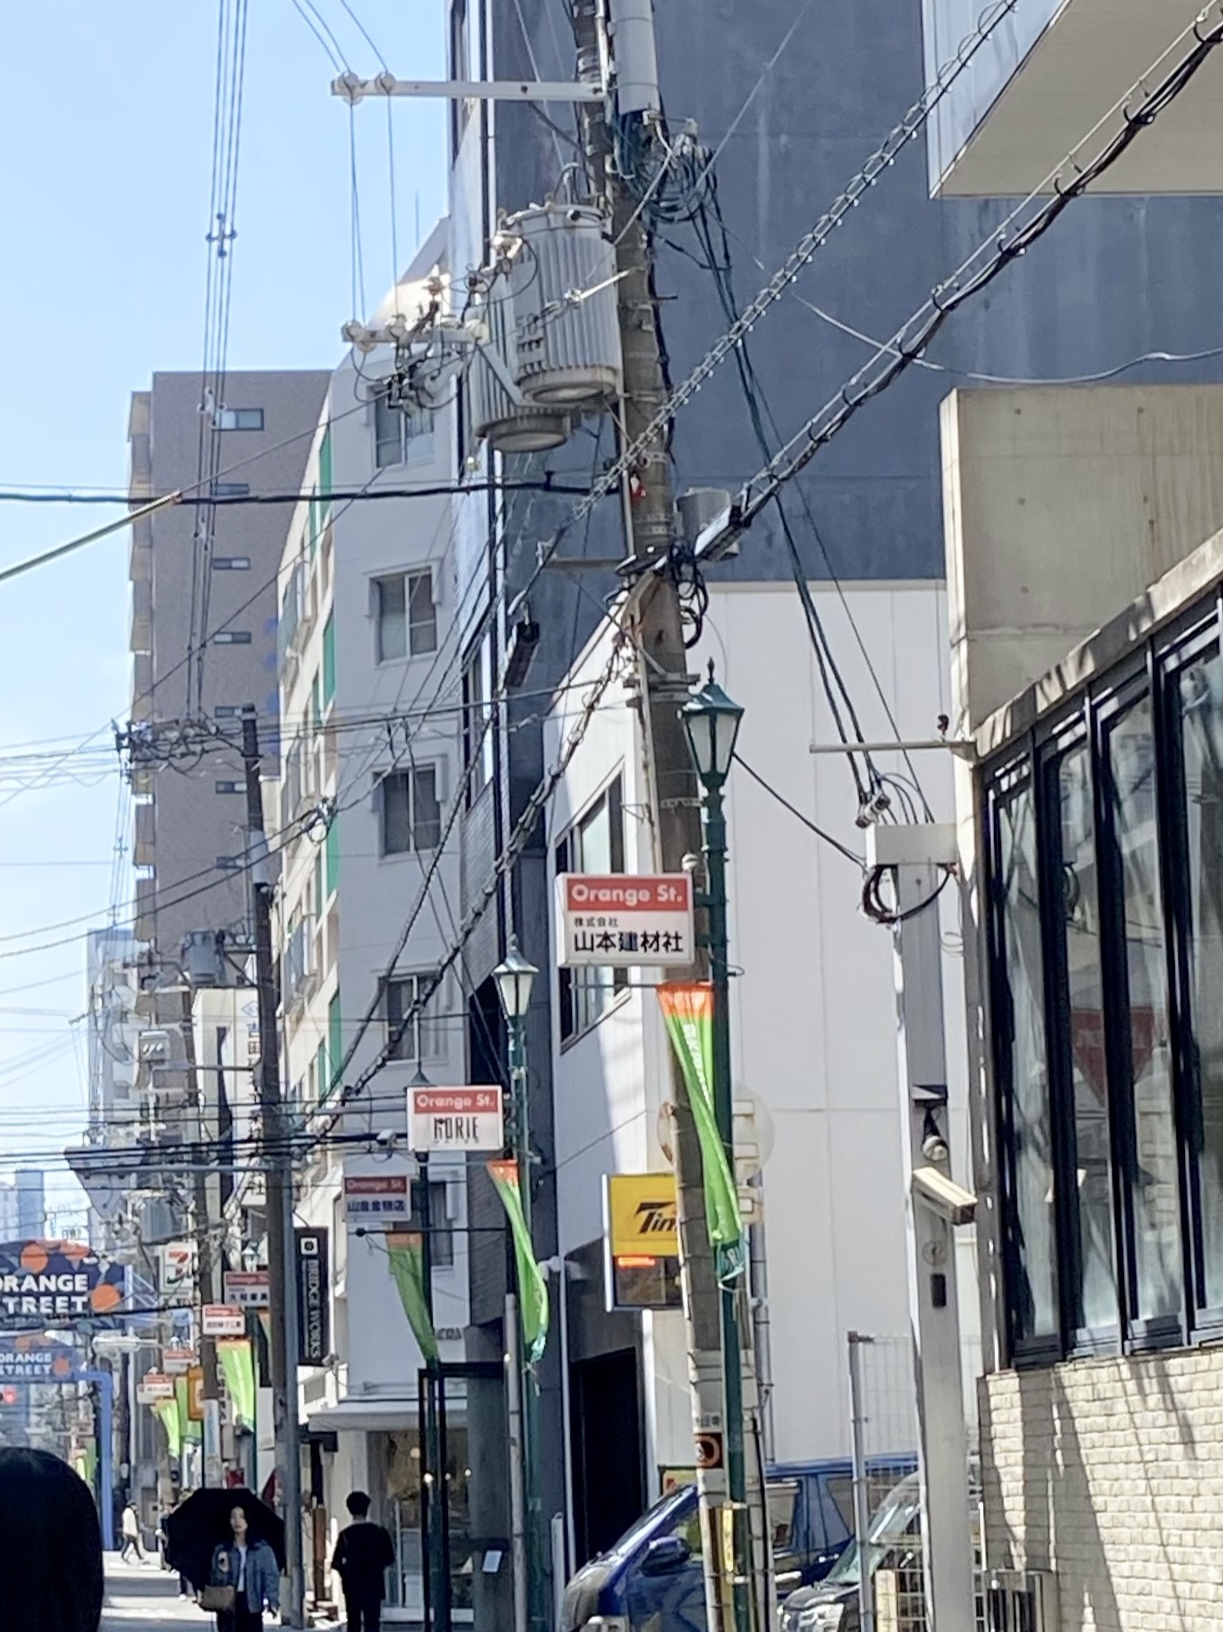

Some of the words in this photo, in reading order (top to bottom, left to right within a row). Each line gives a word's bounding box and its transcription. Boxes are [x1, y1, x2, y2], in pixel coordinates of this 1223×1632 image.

[571, 884, 651, 907] Orange
[657, 884, 683, 902] St.
[574, 917, 619, 928] 株式会社
[574, 930, 683, 953] 山本建材社
[417, 1094, 472, 1110] Orange
[476, 1093, 495, 1107] St.
[308, 1259, 320, 1305] BRIDGE
[309, 1308, 322, 1358] WORKS
